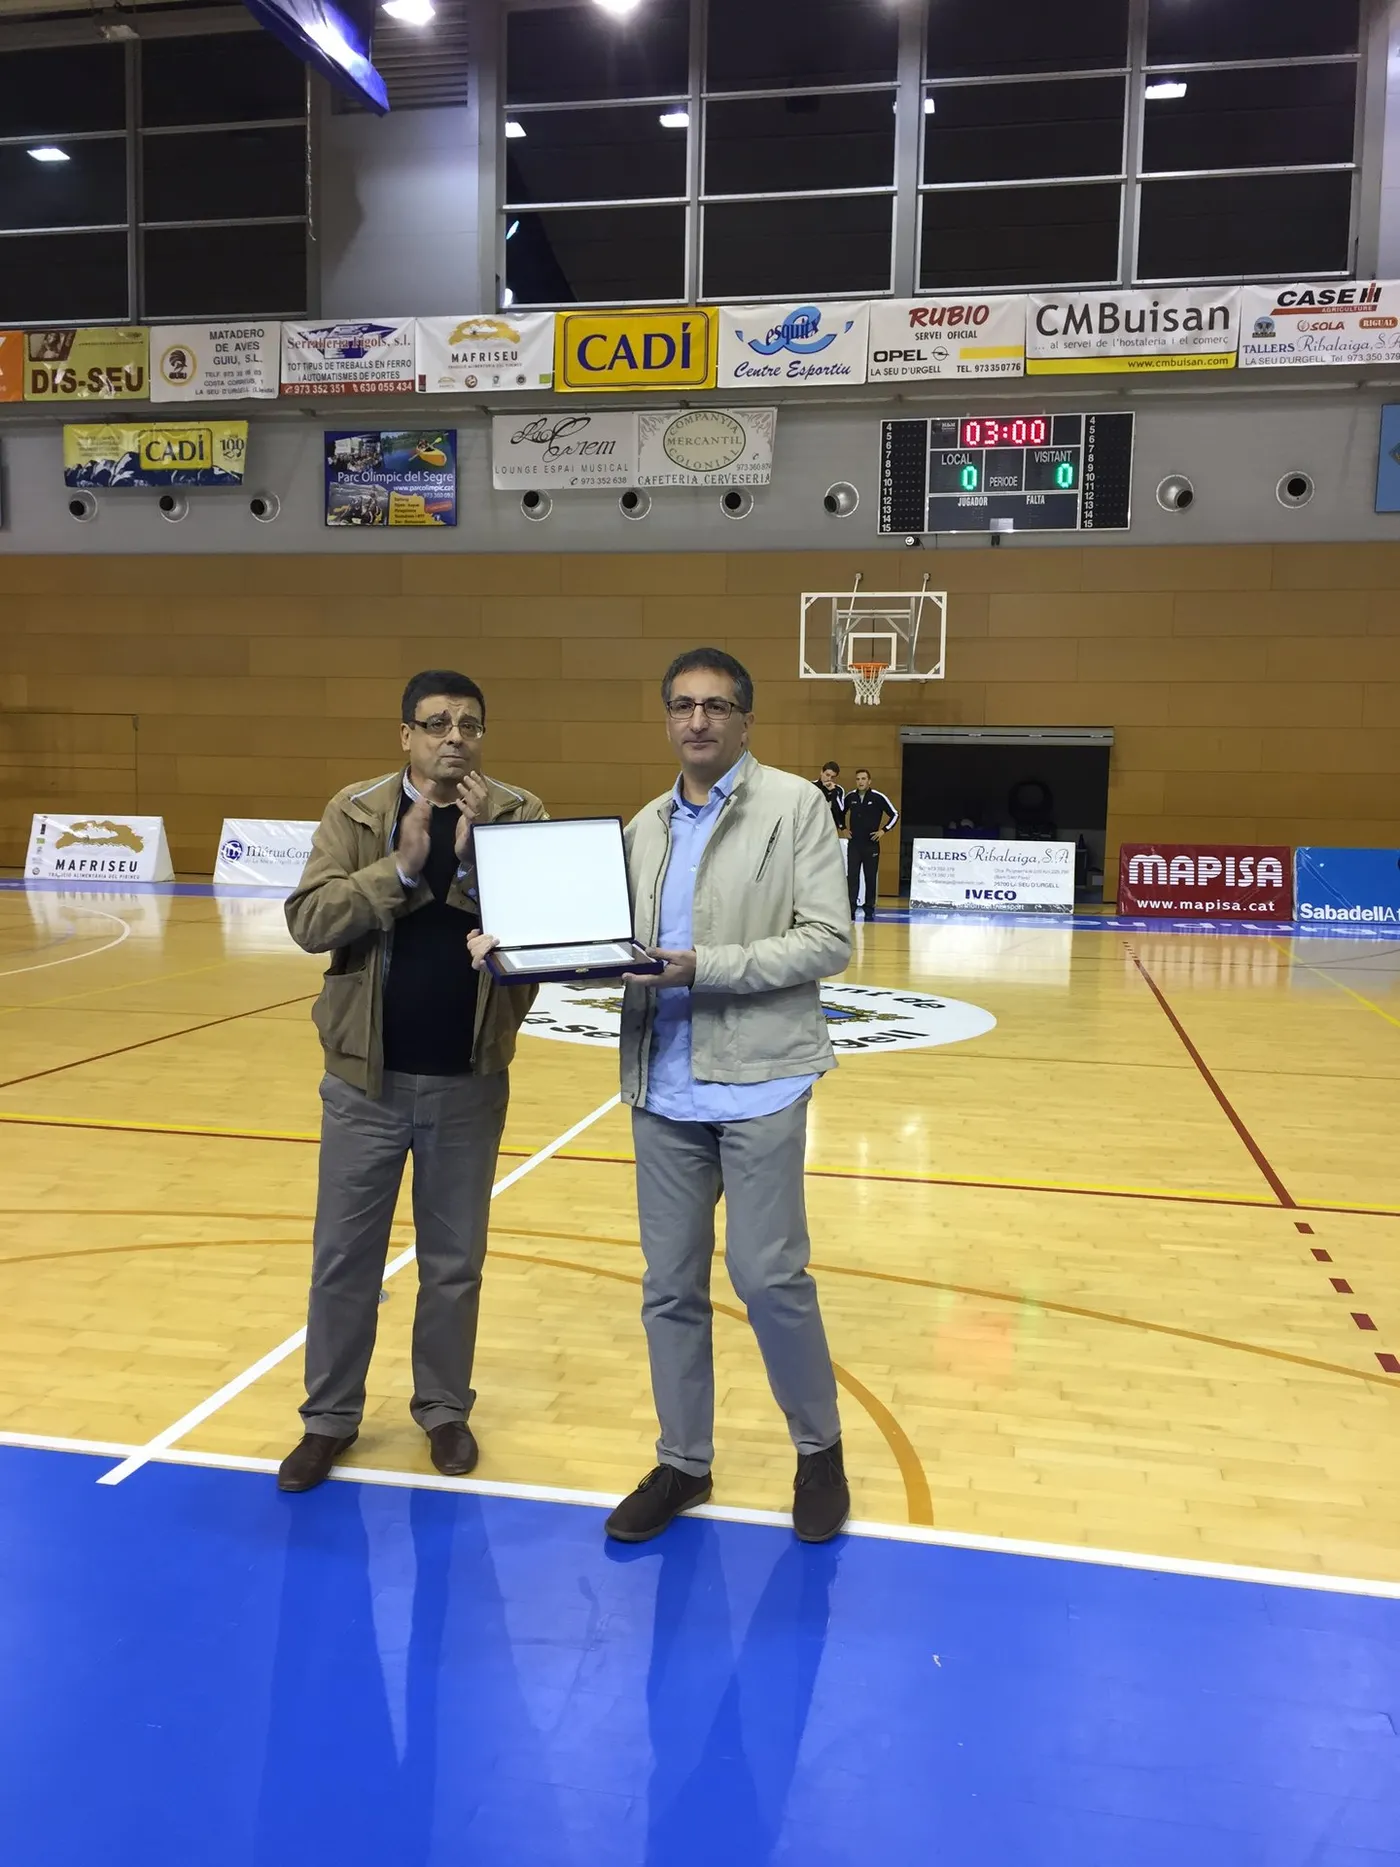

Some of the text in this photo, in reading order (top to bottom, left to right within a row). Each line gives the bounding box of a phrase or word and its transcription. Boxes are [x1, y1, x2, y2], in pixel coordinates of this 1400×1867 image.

[1277, 288, 1356, 307] CASE
[909, 305, 989, 328] RUBIO
[1036, 300, 1229, 336] CMBuisan
[1363, 319, 1394, 327] RIGUAL
[209, 329, 264, 340] MATADERO
[915, 330, 977, 341] SERVEI OFICIAL
[215, 341, 260, 353] DE AVES
[577, 322, 691, 371] CADÍ
[1050, 340, 1059, 349] al
[1063, 339, 1091, 348] servei
[1096, 338, 1108, 348] de
[1112, 337, 1167, 347] l'hostaleria
[1179, 335, 1188, 345] el
[1193, 335, 1229, 345] comerç
[1243, 343, 1295, 354] TALLERS
[245, 354, 263, 363] S.L.
[452, 351, 518, 363] MAFRISEU
[873, 349, 927, 363] OPEL
[1245, 357, 1257, 366] LA
[1258, 356, 1278, 365] SEU
[1280, 355, 1326, 364] D'URGELL
[288, 359, 412, 371] TOT TIPUS DE TREBALLS EN FERRO
[1128, 357, 1229, 368] www.cmbuisan.com
[734, 360, 851, 380] Centre Esportiu
[870, 365, 941, 376] LA SEU D'URGELL
[32, 366, 143, 394] DIS-SEU
[302, 372, 358, 381] AUTOMATISMES
[359, 371, 369, 380] DE
[371, 371, 400, 379] PORTES
[294, 384, 346, 394] 973 352 351
[360, 382, 413, 392] 630 055 434
[670, 413, 739, 436] COMPANYIA
[1089, 416, 1096, 425] 4
[886, 423, 892, 431] 4
[965, 419, 1045, 446] 03:00
[1089, 425, 1096, 434] 5
[667, 436, 742, 446] MERCANTIL
[886, 432, 892, 440] 5
[1088, 435, 1095, 443] 6
[145, 434, 204, 462] CADÍ
[885, 441, 892, 450] 6
[1088, 444, 1095, 453] 7
[668, 447, 739, 470] COLONIAL
[885, 450, 892, 459] 7
[941, 453, 972, 466] LOCAL
[1034, 449, 1073, 463] VISITANT
[1088, 454, 1094, 462] 8
[495, 463, 629, 475] LOUNGE ESPAI MUSICAL
[885, 460, 892, 468] 8
[1087, 463, 1094, 472] 9
[338, 471, 359, 483] Parc
[404, 470, 421, 482] del
[423, 471, 454, 485] Segre
[637, 472, 770, 486] CAFETERIA CERVESERIA
[885, 469, 892, 478] 9
[961, 465, 978, 490] 0
[1057, 462, 1073, 488] 0
[1085, 473, 1095, 481] 10
[596, 477, 611, 485] 352
[612, 476, 627, 484] 638
[883, 478, 893, 487] 10
[989, 475, 1018, 487] PERIODE
[1085, 482, 1095, 490] 11
[883, 487, 892, 496] 11
[1084, 491, 1094, 500] 12
[883, 496, 892, 505] 12
[957, 496, 988, 507] JUGADOR
[1026, 495, 1045, 505] FALTA
[1084, 501, 1094, 509] 13
[882, 505, 892, 514] 13
[1084, 510, 1094, 518] 14
[882, 515, 892, 523] 14
[1083, 519, 1093, 528] 15
[881, 524, 892, 532] 15
[918, 851, 968, 861] TALLERS
[55, 859, 138, 873] MAFRISEU
[1128, 854, 1283, 888] MAPISA
[965, 889, 1017, 901] IVECO
[1136, 899, 1275, 913] www.mapisa.cat
